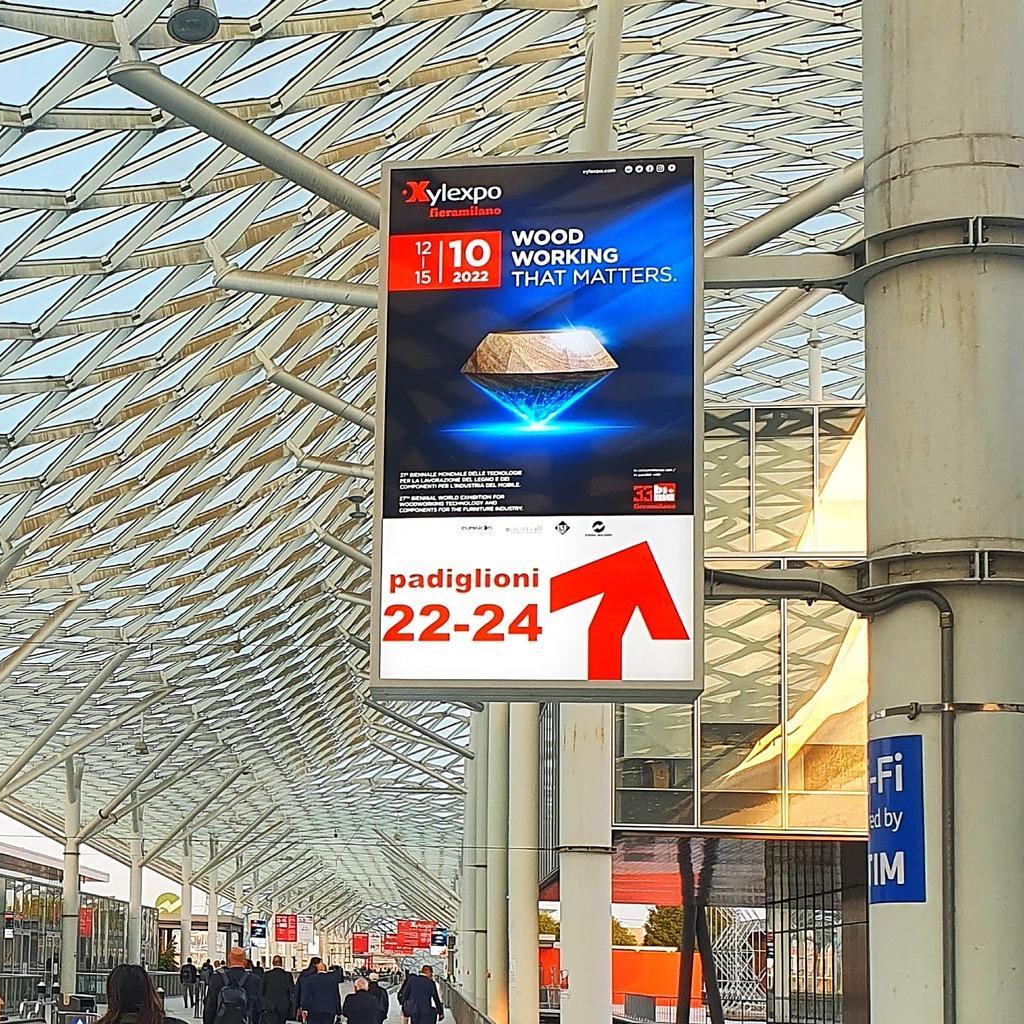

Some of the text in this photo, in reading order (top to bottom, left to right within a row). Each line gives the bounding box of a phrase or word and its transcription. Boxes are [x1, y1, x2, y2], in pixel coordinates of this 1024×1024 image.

[403, 181, 502, 206] Xylexpo
[429, 206, 502, 218] fieramilano
[415, 241, 432, 255] 12
[511, 228, 584, 247] WOOD
[448, 239, 492, 268] 10
[511, 247, 619, 267] WORKING
[414, 270, 432, 285] 15
[452, 271, 490, 283] 2022
[511, 266, 677, 287] THAT MATTERS.
[389, 568, 539, 593] padiglioni
[383, 603, 543, 641] 22-24
[869, 752, 903, 793] -Fi
[870, 807, 903, 832] ed by
